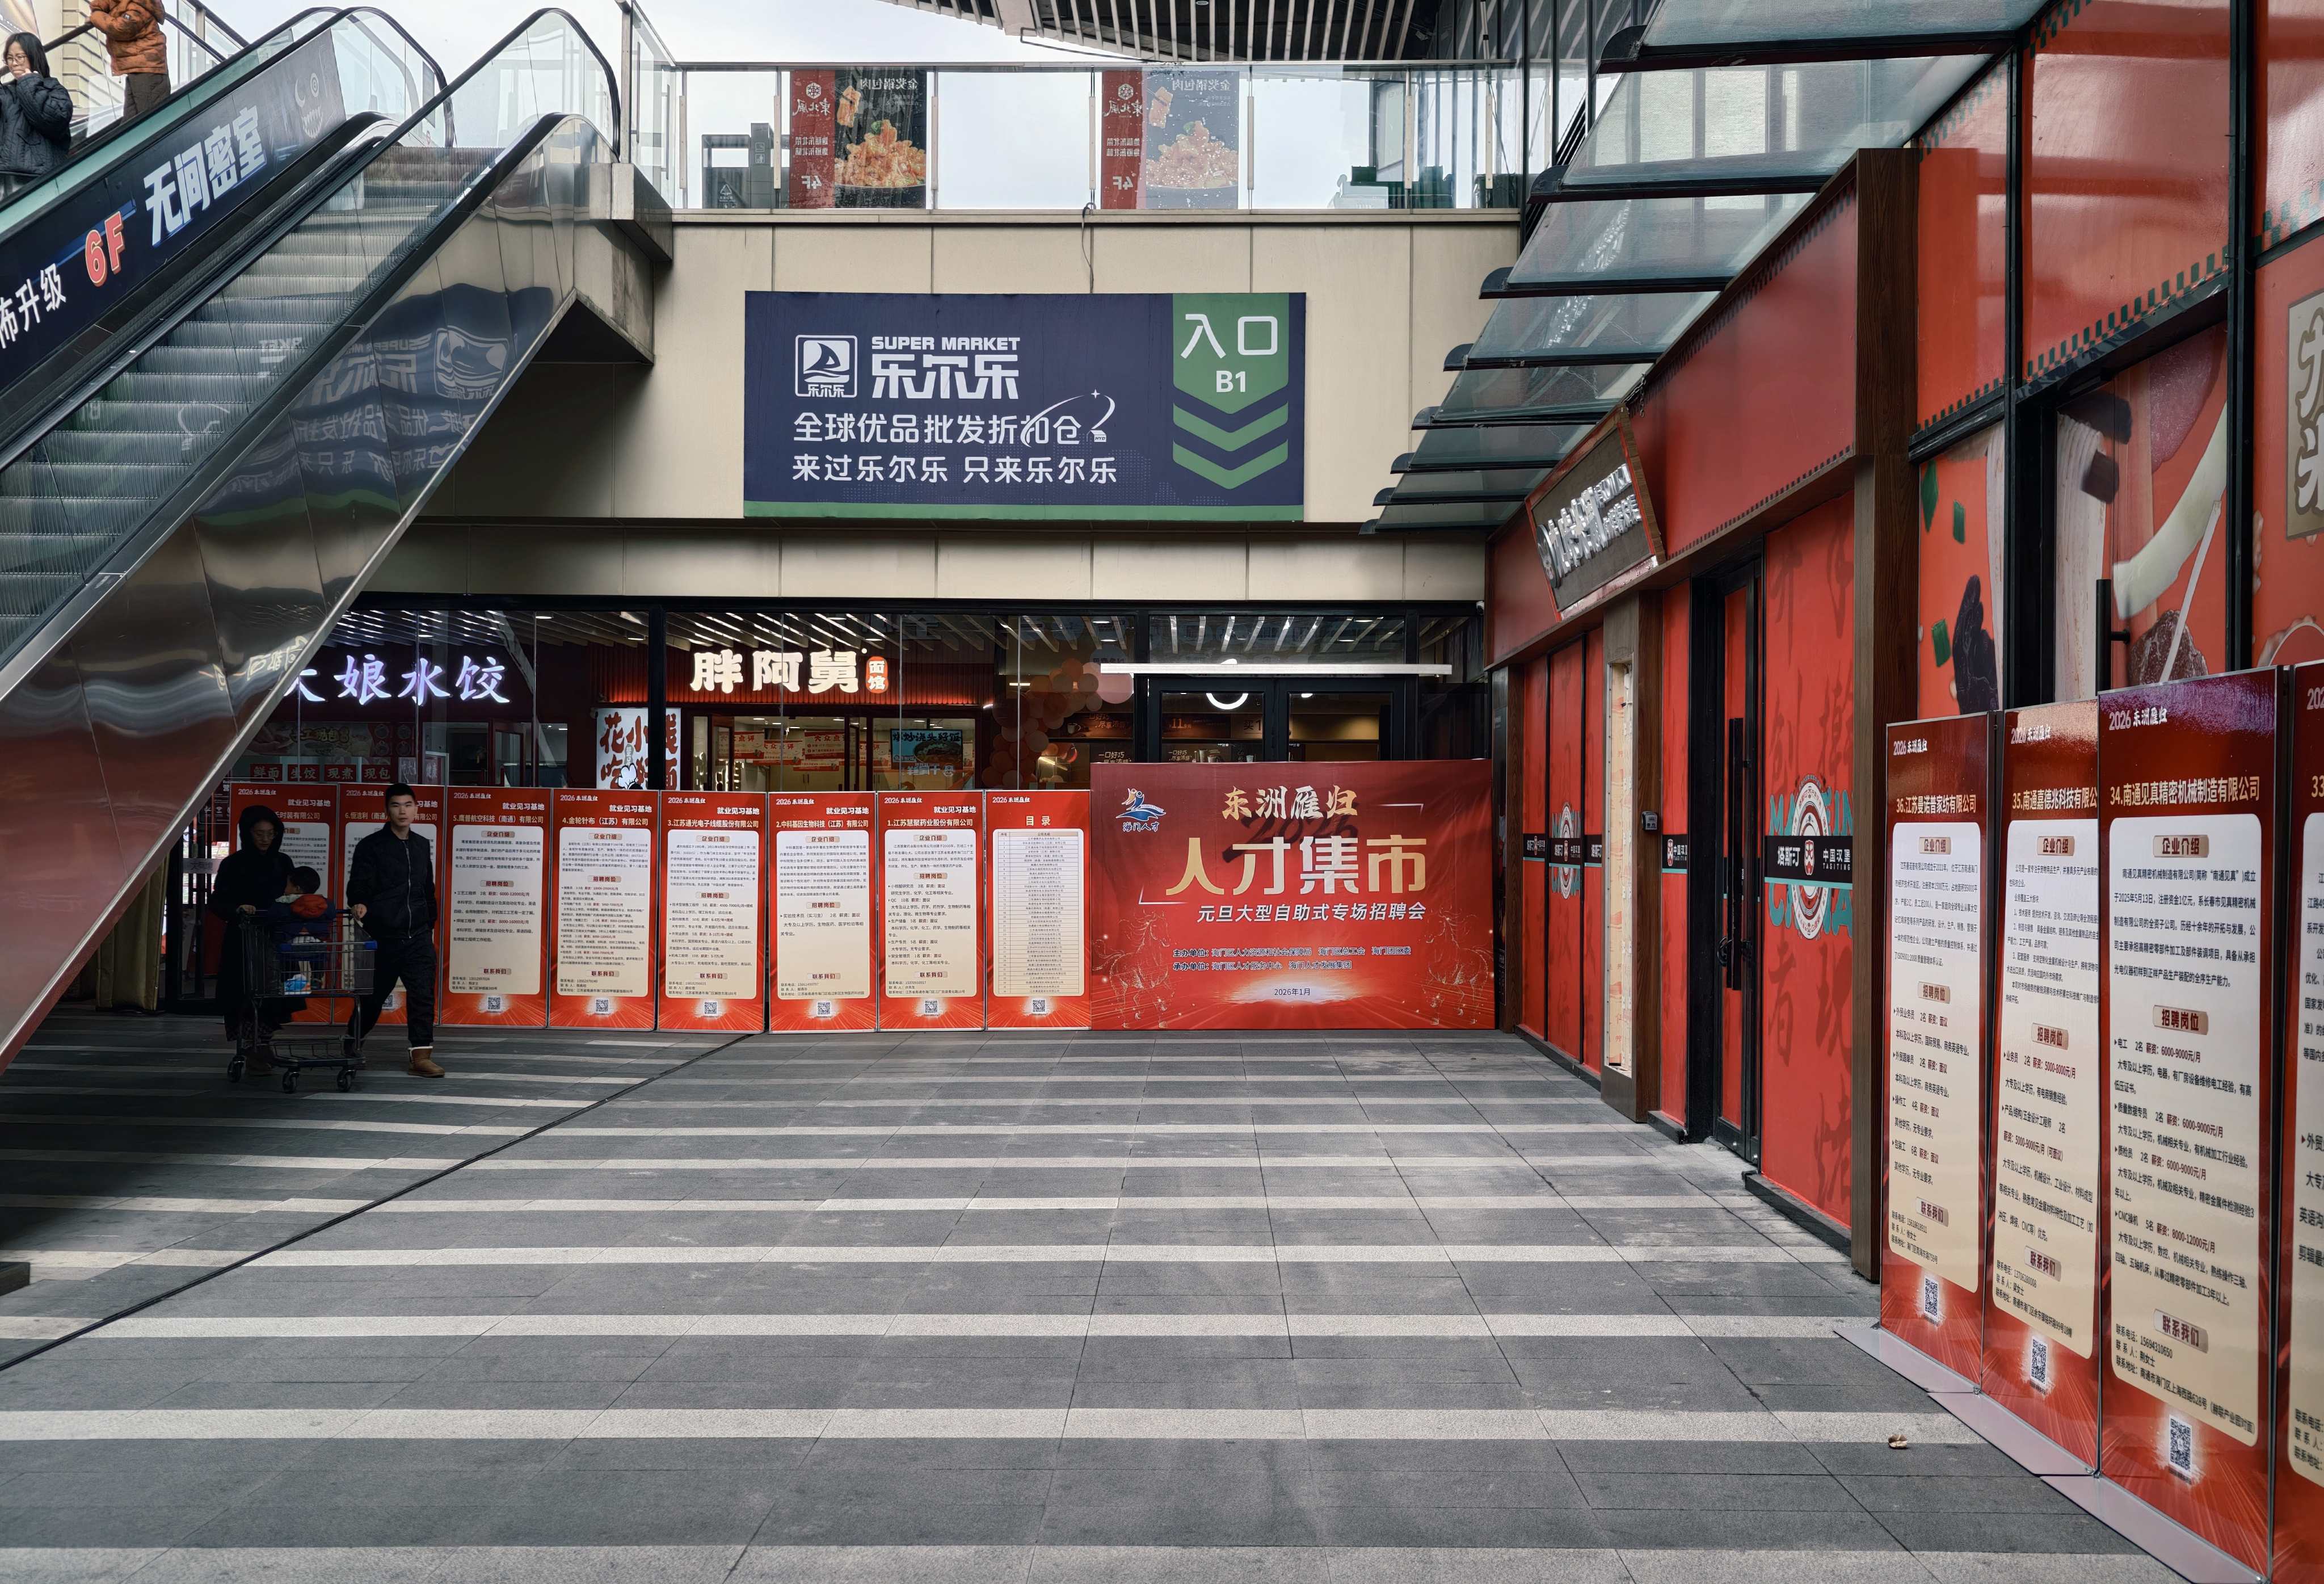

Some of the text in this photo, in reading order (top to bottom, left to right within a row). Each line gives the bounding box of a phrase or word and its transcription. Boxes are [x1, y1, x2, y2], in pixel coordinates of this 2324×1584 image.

[143, 104, 267, 247] 无间密室
[85, 211, 124, 287] 6F
[872, 336, 1020, 350] SUPER MARKET
[1181, 313, 1278, 359] 入口
[872, 354, 1019, 399] 乐尔乐
[1215, 371, 1246, 393] B1
[808, 384, 844, 397] 乐尔乐
[794, 411, 1081, 445] 全球优品批发折扣仓
[792, 454, 1117, 484] 来过乐尔乐 只来乐尔乐
[690, 649, 860, 694] 胖阿舅
[867, 658, 888, 692] 面馆
[2109, 711, 2131, 730] 2026
[2011, 728, 2026, 744] 2026
[1893, 741, 1906, 756] 2026
[254, 766, 280, 778] 鲜面
[290, 767, 317, 779] 生饺
[327, 767, 353, 779] 现煮
[364, 767, 390, 779] 现包
[2110, 775, 2260, 806] 34.南通见真精密机械制造有限公司
[1221, 785, 1358, 821] 东洲雁归
[1896, 795, 1976, 814] 36.江苏曼诺普家纺有限公司
[1026, 816, 1051, 826] 目 录
[1122, 822, 1159, 832] 海门人才
[1778, 846, 1800, 867] 塔斯汀
[1823, 849, 1850, 863] 中国汉堡
[1924, 838, 1946, 853] 企业介绍
[2043, 838, 2068, 854] 企业介绍
[2162, 838, 2199, 855] 企业介绍
[1165, 834, 1427, 896] 人才集市
[2114, 893, 2256, 909] 于2025年5月13日，注册资金1亿元，系长春市见真精密机械
[1198, 902, 1426, 924] 元旦大型自助式专场招聘会
[2114, 917, 2255, 935] 制造有限公司的全资子公司。历经十余年的开拓与发展，公
[1319, 947, 1365, 956] 海门区总工会
[1371, 947, 1411, 955] 海门团区委
[2114, 940, 2255, 963] 司主要承担高精密零部件加工及部件装调项目，具备从承担
[1173, 961, 1352, 970] 承办单位：海门区人才服务中心 海门人才发展集团
[2114, 964, 2232, 988] 光电仪器初样到正样产品生产装配的全序生产能力。
[1923, 984, 1945, 1001] 招聘岗位
[2162, 1009, 2199, 1031] 招聘岗位
[2037, 1025, 2062, 1045] 招聘岗位
[2118, 1037, 2201, 1063] 电工 2名 薪资：6000-9000元/月
[2006, 1051, 2075, 1079] 业务员 2名 薪资：5000-8000元/月
[2115, 1080, 2137, 1095] 低压证书。
[2117, 1060, 2251, 1096] 大专及以上学历，电器，有厂房设备维修电工经验，有高
[2005, 1078, 2068, 1106] 大专及以上学历，有电商销售经验。
[2058, 1122, 2065, 1133] 2名
[2118, 1102, 2223, 1138] 质量数据专员 2名 薪资：6000-9000元/月
[2117, 1124, 2249, 1169] 大专及以上学历，机械相关专业，有机械加工行业经验。
[2118, 1145, 2206, 1181] 质检员 2名 薪资：6000-9000元/月
[2002, 1158, 2093, 1203] 大专及以上学历，机械设计、工业设计、材料成型
[2115, 1188, 2132, 1202] 年以上。
[2117, 1167, 2254, 1218] 大专及以上学历，机械及相关专业，精密金属件检测经验3
[1921, 1201, 1943, 1222] 联系我们
[2118, 1211, 2215, 1253] CNC操机 5名 薪资：8000-12000元/月
[2030, 1250, 2055, 1276] 联系我们
[2118, 1231, 2248, 1290] 大专及以上学历，数控、机械相关专业，熟练操作三轴、
[2115, 1253, 2230, 1306] 四轴、五轴机床，从事过精密零部件加工3年以上。
[2116, 1323, 2173, 1359] 联系电话：15694310650
[2162, 1315, 2200, 1347] 联系我们
